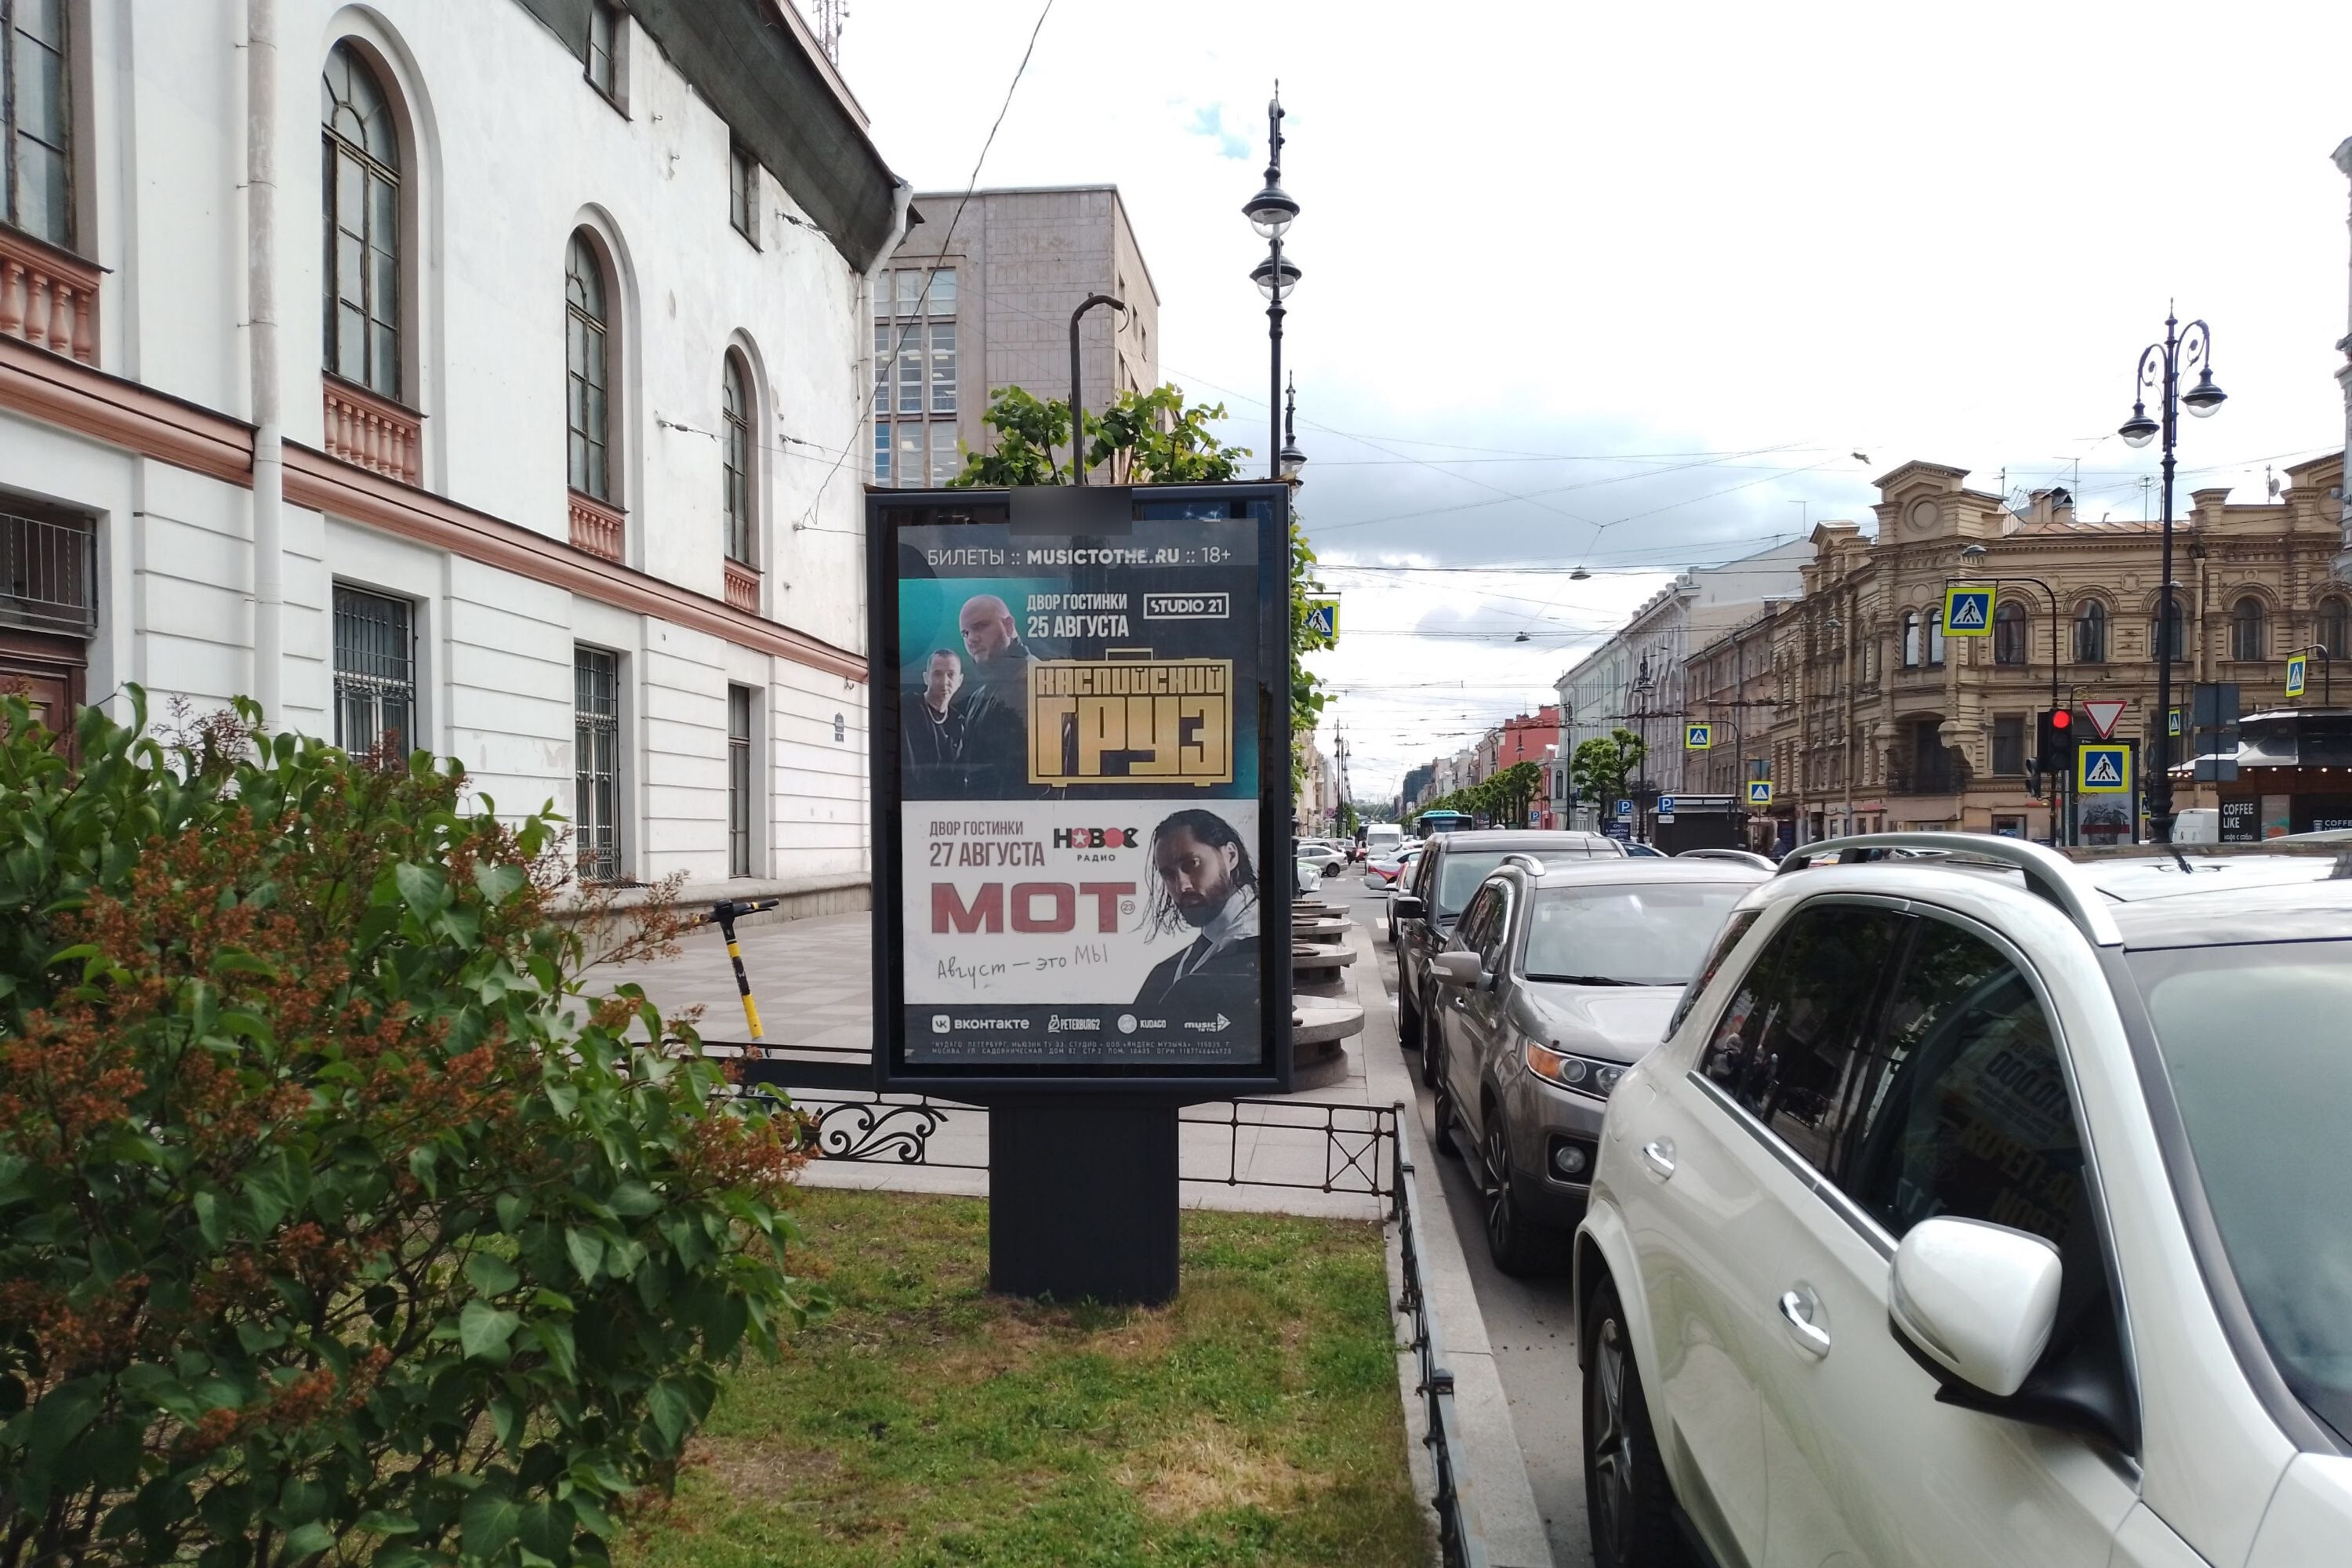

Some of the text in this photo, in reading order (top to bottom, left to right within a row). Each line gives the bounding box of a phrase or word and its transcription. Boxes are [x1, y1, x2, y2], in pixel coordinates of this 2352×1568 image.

[927, 549, 1004, 566] БИЛЕТЫ
[1027, 548, 1180, 565] MUSICTOTHE.RU
[1201, 546, 1231, 563] 18+
[1026, 593, 1127, 612] ДВОР ГОСТИНКИ
[1150, 599, 1223, 613] STUDIO 21
[1027, 615, 1130, 637] 25 АВГУСТА
[1036, 666, 1225, 695] КАСПИЙСКИЙ
[1036, 696, 1225, 776] ГРУЗ
[2223, 803, 2254, 815] COFFEE
[930, 821, 1023, 837] ДВОР ГОСТИНКИ
[2223, 817, 2240, 829] LIKE
[930, 842, 1045, 867] 27 АВГУСТА
[931, 882, 1136, 934] МОТ
[938, 956, 1006, 989] Август
[1036, 957, 1066, 971] это
[1075, 943, 1108, 965] МЫ
[1140, 1020, 1167, 1029] KUDAGO
